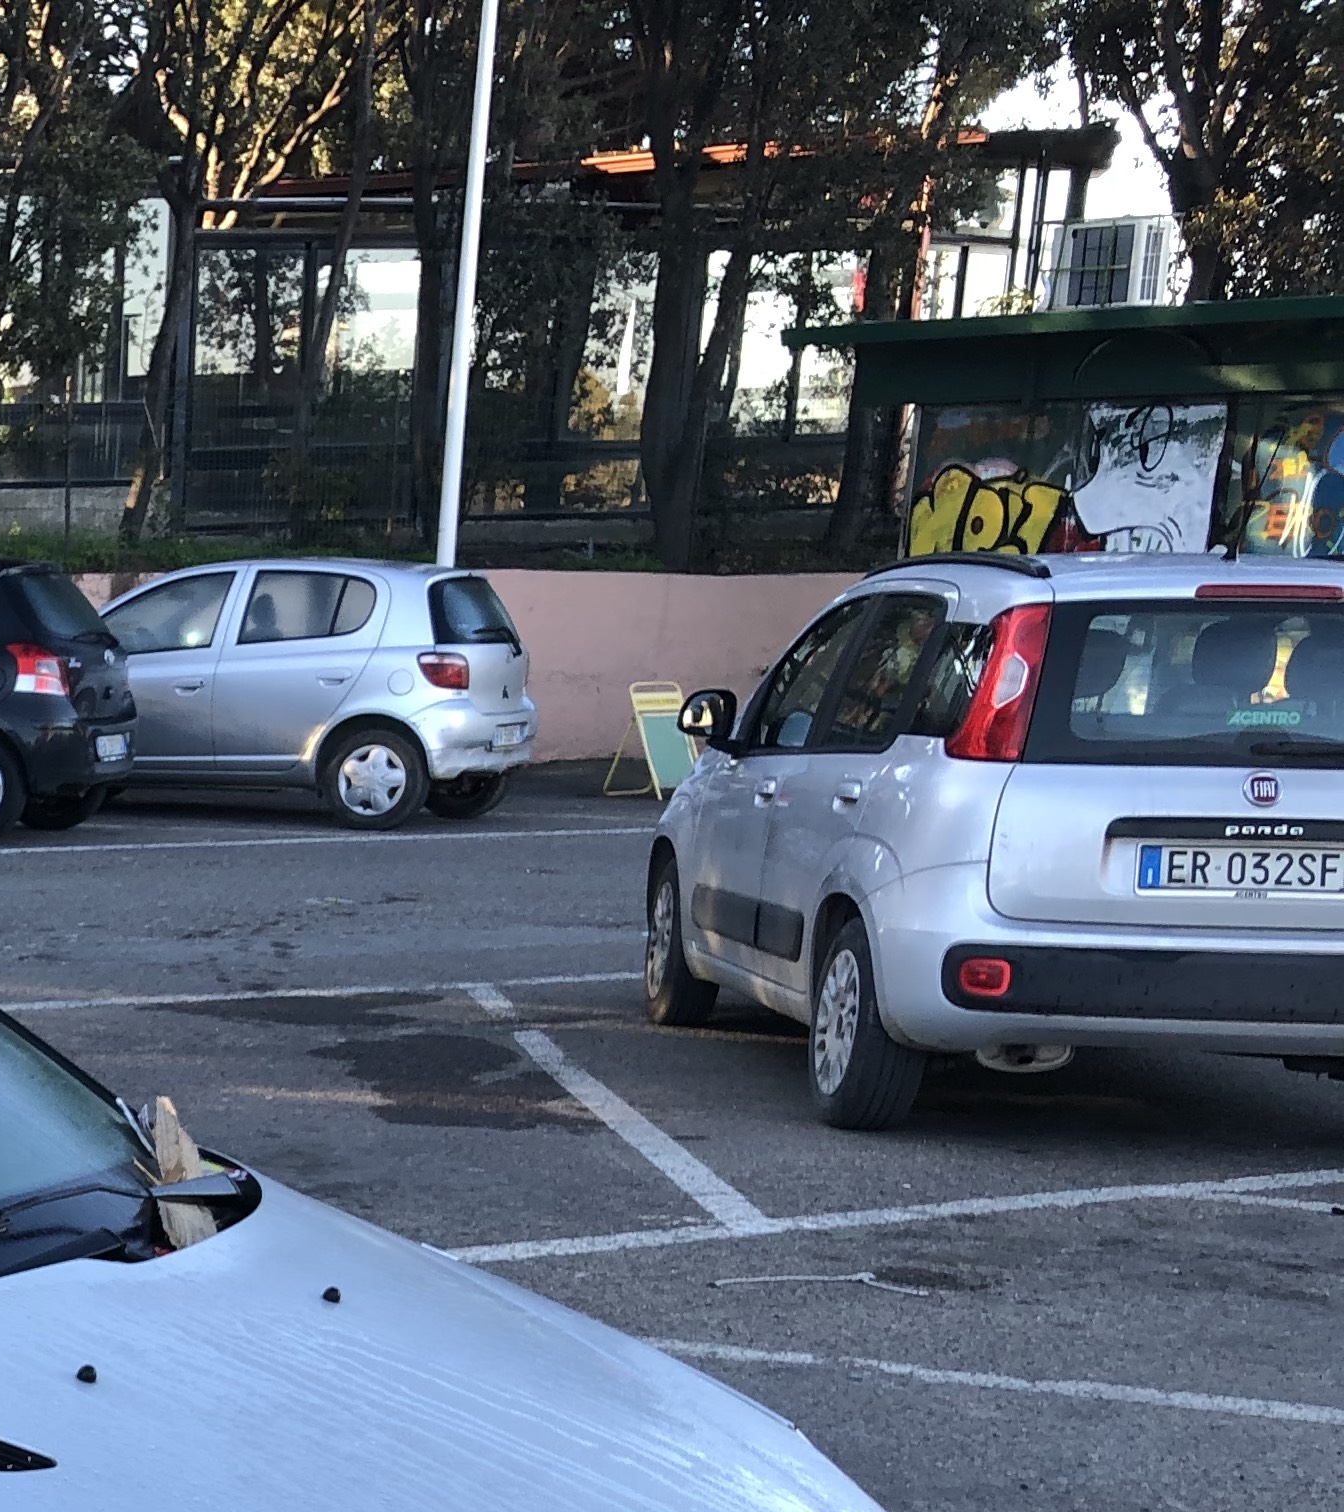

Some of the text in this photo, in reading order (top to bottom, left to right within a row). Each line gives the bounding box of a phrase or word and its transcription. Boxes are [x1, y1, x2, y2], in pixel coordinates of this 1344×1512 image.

[1226, 710, 1301, 726] ACENTRO
[1253, 780, 1277, 798] FIAT
[1224, 823, 1304, 837] panda
[1166, 850, 1341, 888] ER 032SF
